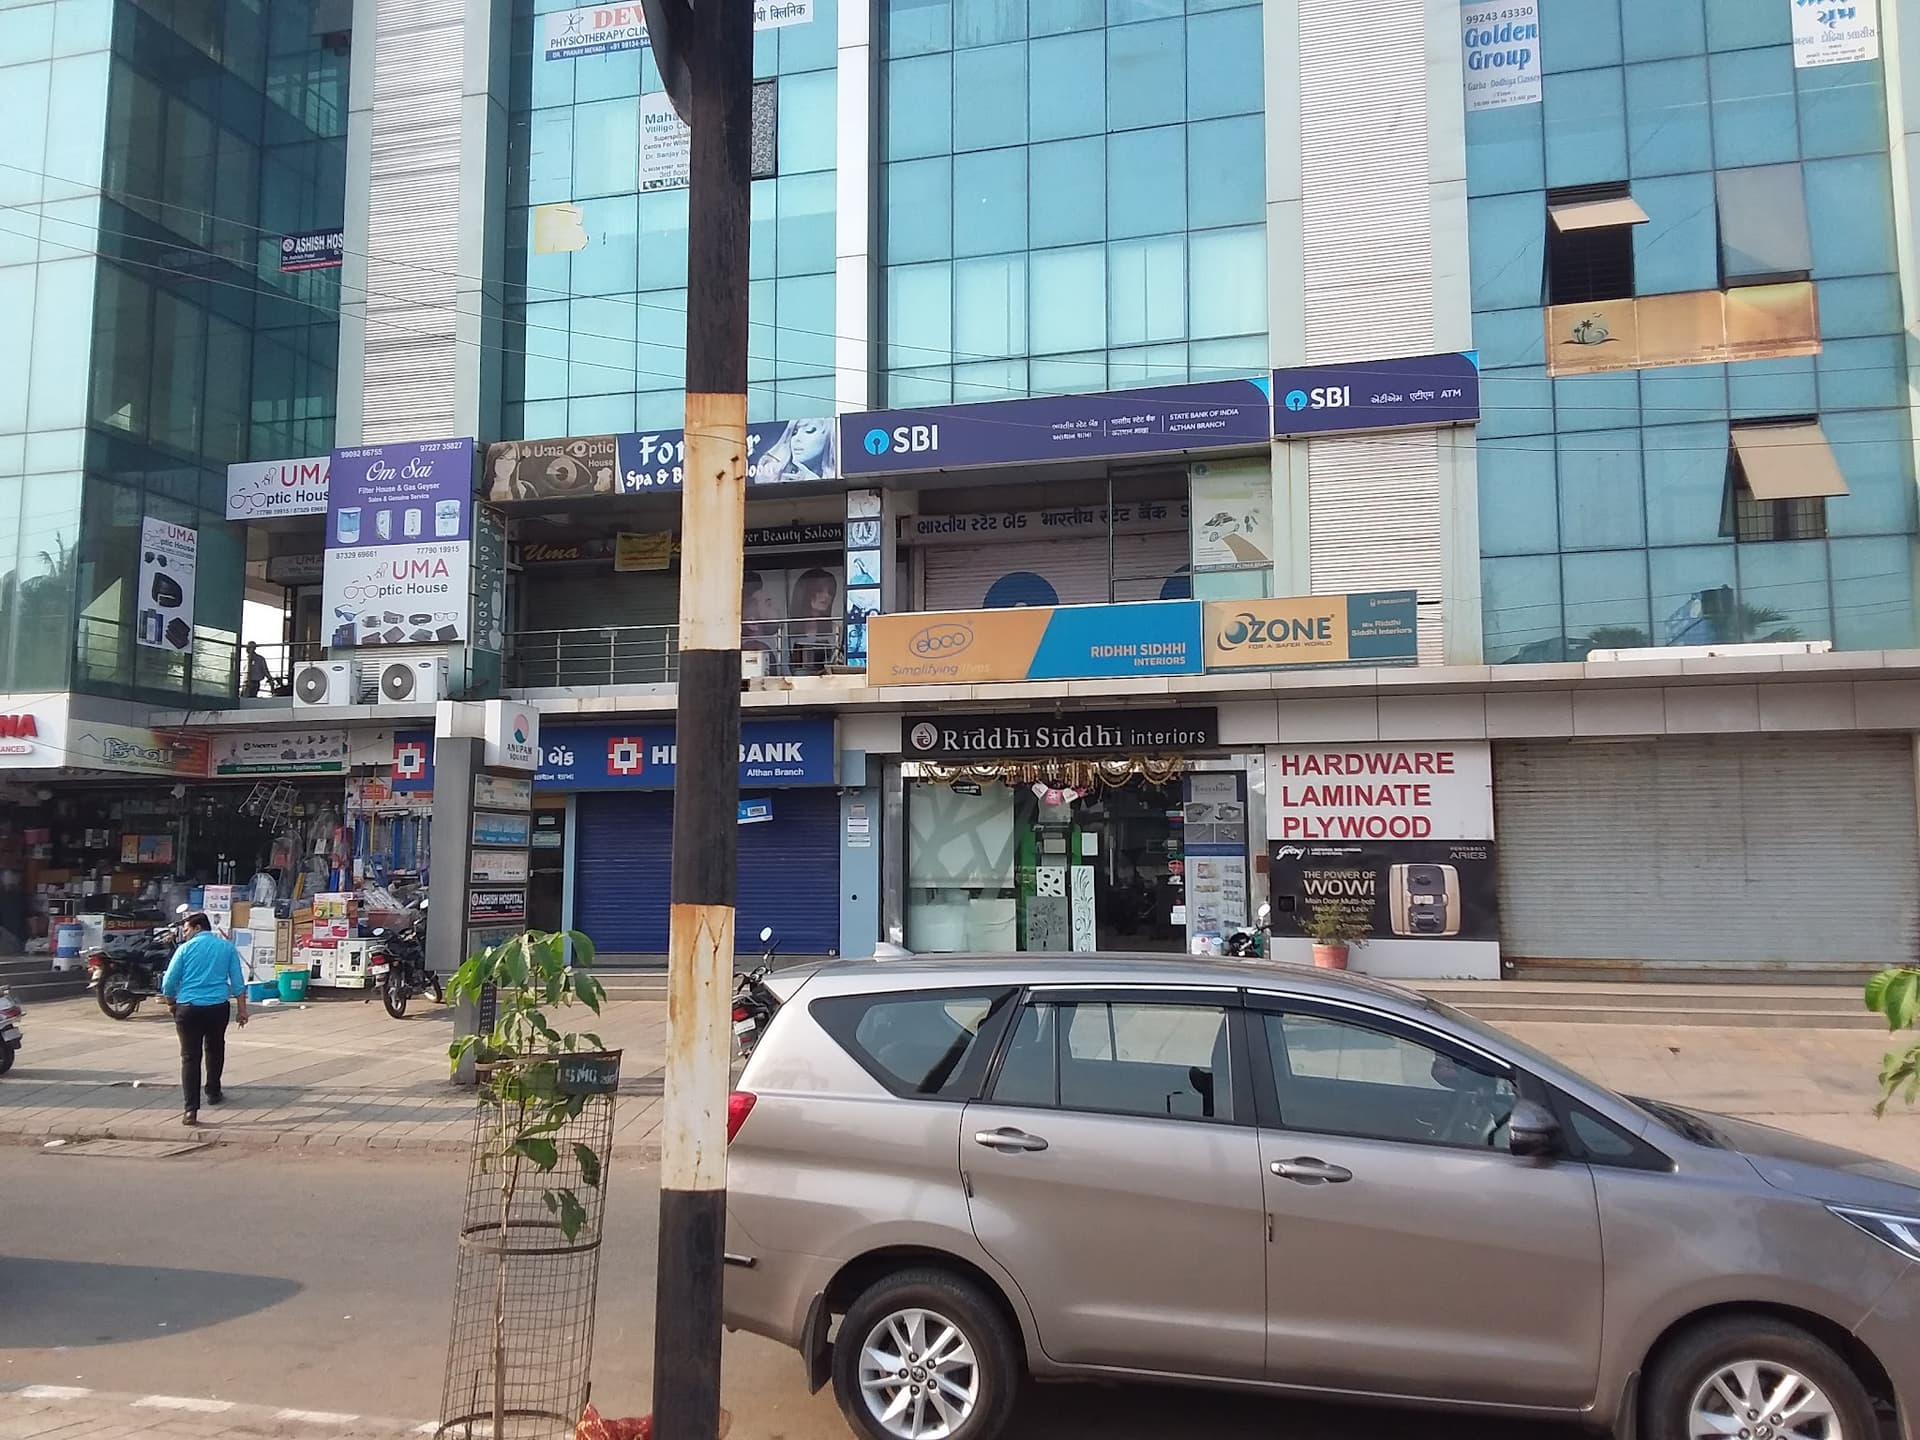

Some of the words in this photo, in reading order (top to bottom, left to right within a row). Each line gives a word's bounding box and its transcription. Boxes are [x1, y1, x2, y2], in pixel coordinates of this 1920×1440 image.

[1466, 12, 1497, 24] 99243
[1501, 6, 1533, 19] 43330
[551, 29, 625, 48] PHYSIOTHERAPY
[1465, 22, 1538, 48] Golden
[1468, 48, 1531, 70] Group
[645, 124, 674, 134] Vitiligo
[295, 235, 325, 253] ASHISH
[1310, 385, 1350, 409] SBI
[1441, 389, 1462, 398] ATM
[1169, 413, 1189, 421] STATE
[1190, 411, 1208, 419] BANK
[1219, 408, 1239, 416] INDIA
[1169, 423, 1195, 431] ALTHAN
[1197, 421, 1226, 430] BRANCH
[893, 424, 939, 454] SBI
[366, 460, 397, 481] Om
[401, 457, 435, 479] Sai
[588, 458, 614, 467] House
[626, 469, 652, 490] Spa
[656, 468, 669, 484] &
[358, 486, 375, 494] Filter
[375, 485, 396, 493] House
[917, 515, 966, 534] ભારતીય
[1041, 507, 1093, 528] भारतीय
[168, 526, 195, 545] UMA
[763, 530, 801, 544] Beauty
[805, 526, 842, 539] Saloon
[336, 552, 356, 560] 87329
[392, 559, 449, 580] UMA
[406, 583, 448, 595] House
[1091, 645, 1137, 658] RIDHHI
[1140, 642, 1186, 656] SIDHHI
[1133, 655, 1186, 667] INTERIORS
[891, 663, 959, 679] Simplifying
[942, 727, 1031, 750] Riddhi
[1036, 724, 1123, 748] Siddhi
[1130, 728, 1206, 745] interiors
[506, 743, 532, 755] ANUPAM
[747, 768, 773, 777] Althan
[775, 768, 804, 777] Branch
[1281, 752, 1455, 776] HARDWARE
[1282, 784, 1432, 807] LAMINATE
[1283, 815, 1432, 839] PLYWOOD
[1450, 851, 1488, 860] ARIES
[1303, 871, 1321, 879] THE
[1323, 871, 1360, 879] POWER
[1362, 870, 1377, 879] OF
[1303, 879, 1376, 896] WOW!
[1305, 897, 1321, 905] Main
